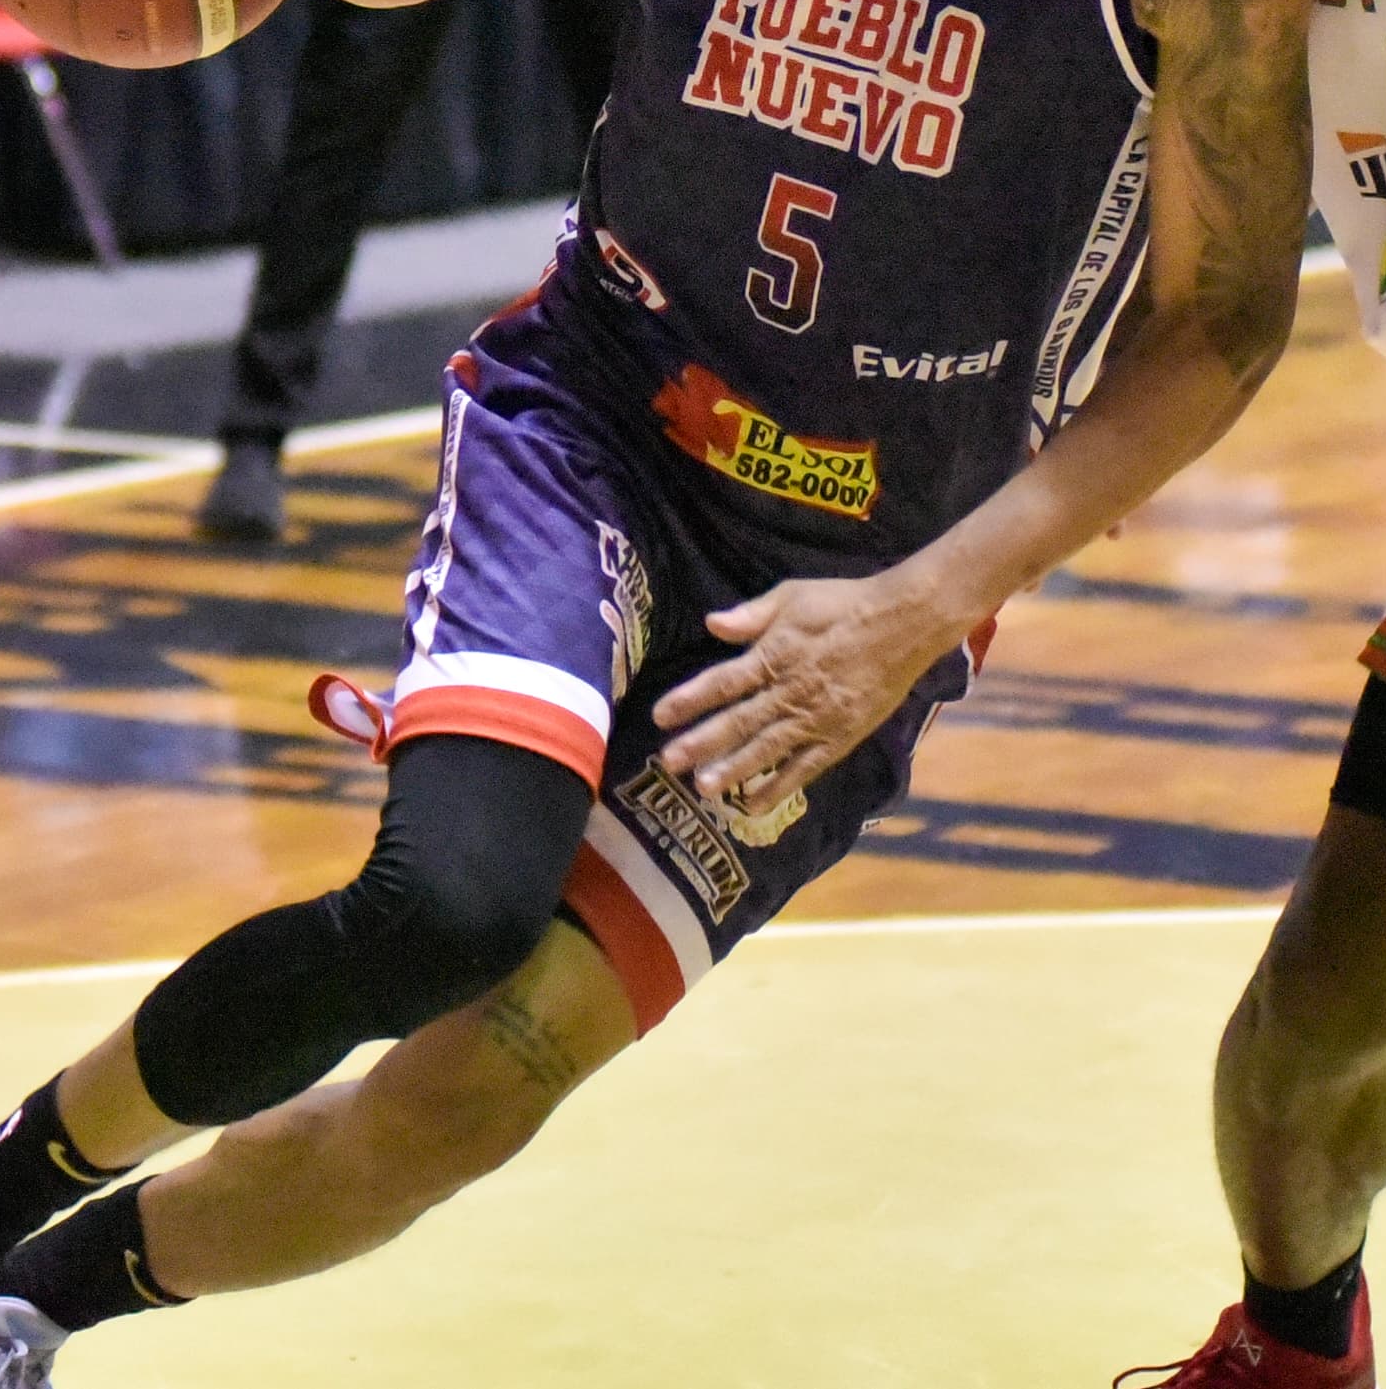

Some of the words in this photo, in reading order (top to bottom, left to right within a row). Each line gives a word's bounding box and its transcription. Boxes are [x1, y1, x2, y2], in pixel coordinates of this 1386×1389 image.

[685, 28, 961, 175] NUEVO
[1092, 171, 1142, 245] CAPITAL
[745, 172, 838, 335] 5
[1080, 251, 1109, 273] DE
[1063, 277, 1096, 313] LOS
[735, 453, 869, 508] 582-0000
[743, 418, 795, 460] EL
[801, 451, 875, 485] SOL
